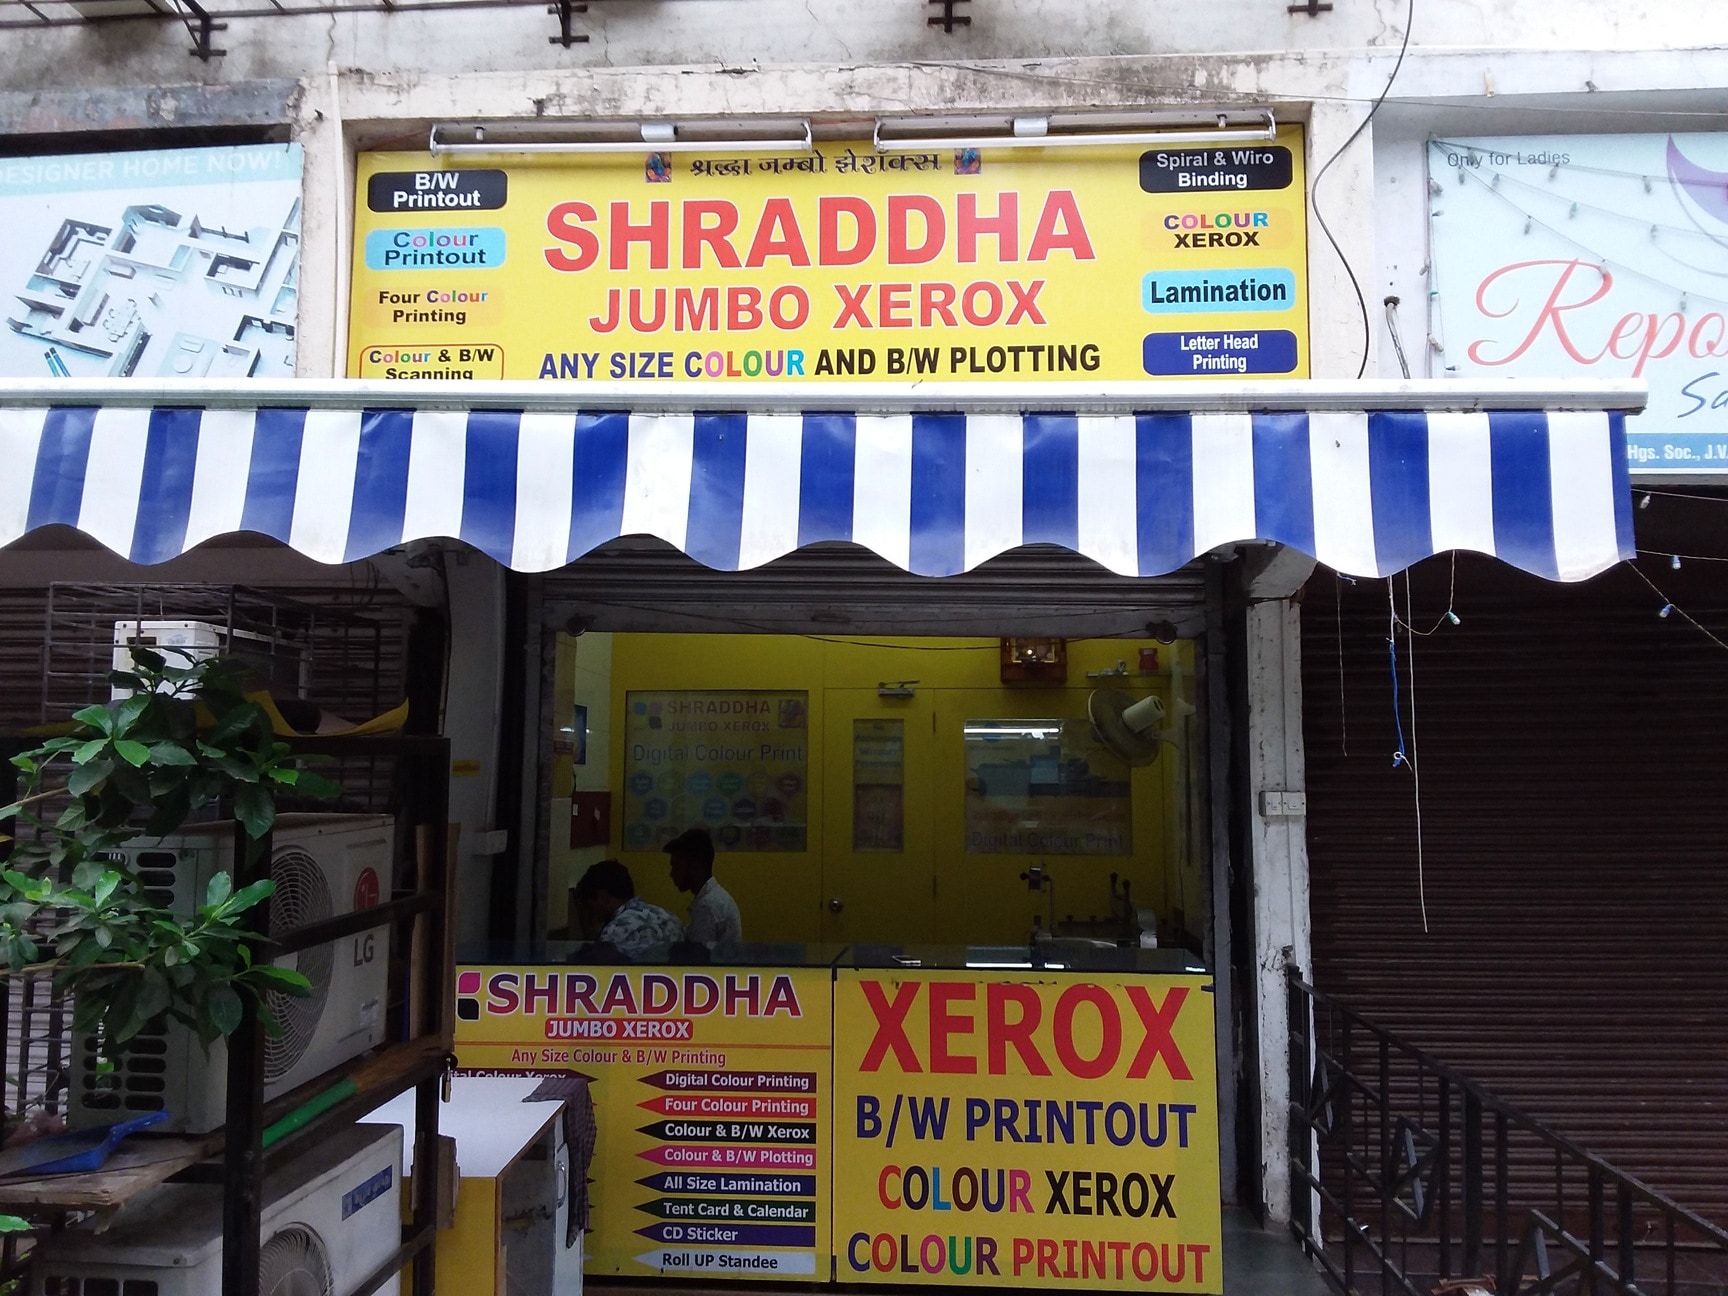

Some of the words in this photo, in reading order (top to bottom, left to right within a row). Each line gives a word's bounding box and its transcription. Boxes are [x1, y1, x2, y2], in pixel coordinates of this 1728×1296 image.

[123, 155, 198, 178] HOME
[208, 150, 281, 172] NOW!
[690, 158, 752, 176] श्रद्धा
[758, 150, 826, 174] जम्बो
[833, 149, 942, 174] झेरॉक्स
[1156, 151, 1208, 170] Spiral
[1213, 152, 1226, 167] &
[1230, 150, 1274, 165] Wiro
[1488, 152, 1513, 165] for
[1517, 151, 1570, 165] Ladies
[415, 172, 459, 190] B/W
[1178, 170, 1248, 190] Binding
[393, 189, 481, 208] Printout
[1164, 212, 1269, 230] COLOUR
[393, 230, 478, 249] Colour
[544, 190, 1096, 271] SHRADDHA
[1174, 232, 1260, 249] XEROX
[385, 248, 486, 267] Printout
[379, 290, 420, 304] Four
[427, 289, 488, 303] Colour
[1150, 280, 1287, 304] Lamination
[589, 285, 809, 333] JUMBO
[832, 280, 1047, 330] XEROX
[393, 309, 467, 326] Printing
[1180, 334, 1219, 351] Letter
[1223, 333, 1258, 350] Head
[369, 350, 431, 363] Colour
[438, 349, 451, 362] &
[459, 349, 494, 362] B/W
[539, 352, 600, 378] ANY
[609, 352, 673, 378] SIZE
[685, 349, 805, 377] COLOUR
[815, 348, 875, 374] AND
[886, 347, 940, 374] B/W
[950, 344, 1100, 372] PLOTTING
[1192, 352, 1248, 372] Printing
[386, 368, 473, 379] Scanning
[1627, 445, 1659, 462] Hgs.
[1664, 444, 1700, 461] Soc.,
[668, 700, 771, 714] SHRADDHA
[669, 721, 717, 732] JUMBO
[723, 721, 770, 732] XEROX
[633, 744, 688, 764] Digital
[695, 744, 754, 761] Colour
[760, 744, 803, 761] Print
[971, 832, 1022, 849] Digital
[1027, 832, 1081, 848] Colour
[1087, 833, 1123, 848] Print
[354, 934, 374, 966] LG
[487, 973, 802, 1018] SHRADDHA
[548, 1021, 617, 1038] JUMBO
[622, 1021, 689, 1038] XEROX
[858, 980, 1194, 1081] XEROX
[511, 1049, 537, 1065] Any
[541, 1049, 569, 1063] Size
[573, 1049, 618, 1064] Colour
[621, 1050, 631, 1063] &
[636, 1050, 667, 1065] B/W
[671, 1050, 726, 1067] Printing
[665, 1073, 707, 1088] Digital
[711, 1074, 753, 1087] Colour
[757, 1075, 809, 1089] Printing
[665, 1098, 697, 1111] Four
[701, 1099, 747, 1113] Colour
[752, 1100, 808, 1115] Printing
[856, 1094, 950, 1148] B/W
[966, 1098, 1196, 1148] PRINTOUT
[664, 1123, 712, 1137] Colour
[716, 1124, 727, 1137] &
[731, 1124, 764, 1139] B/W
[768, 1125, 809, 1139] Xerox
[664, 1149, 708, 1162] Colour
[711, 1149, 721, 1162] &
[726, 1150, 757, 1164] B/W
[760, 1151, 813, 1166] Plotting
[664, 1176, 682, 1190] All
[686, 1176, 716, 1190] Size
[721, 1177, 801, 1192] Lamination
[878, 1164, 1035, 1214] COLOUR
[1045, 1170, 1176, 1218] XEROX
[664, 1203, 694, 1216] Tent
[698, 1203, 729, 1217] Card
[733, 1204, 744, 1217] &
[747, 1204, 809, 1218] Calendar
[662, 1226, 682, 1240] CD
[687, 1227, 738, 1241] Sticker
[662, 1253, 690, 1266] Roll
[694, 1254, 714, 1267] UP
[718, 1254, 778, 1269] Standee
[848, 1232, 1000, 1275] COLOUR
[1013, 1238, 1210, 1283] PRINTOUT
